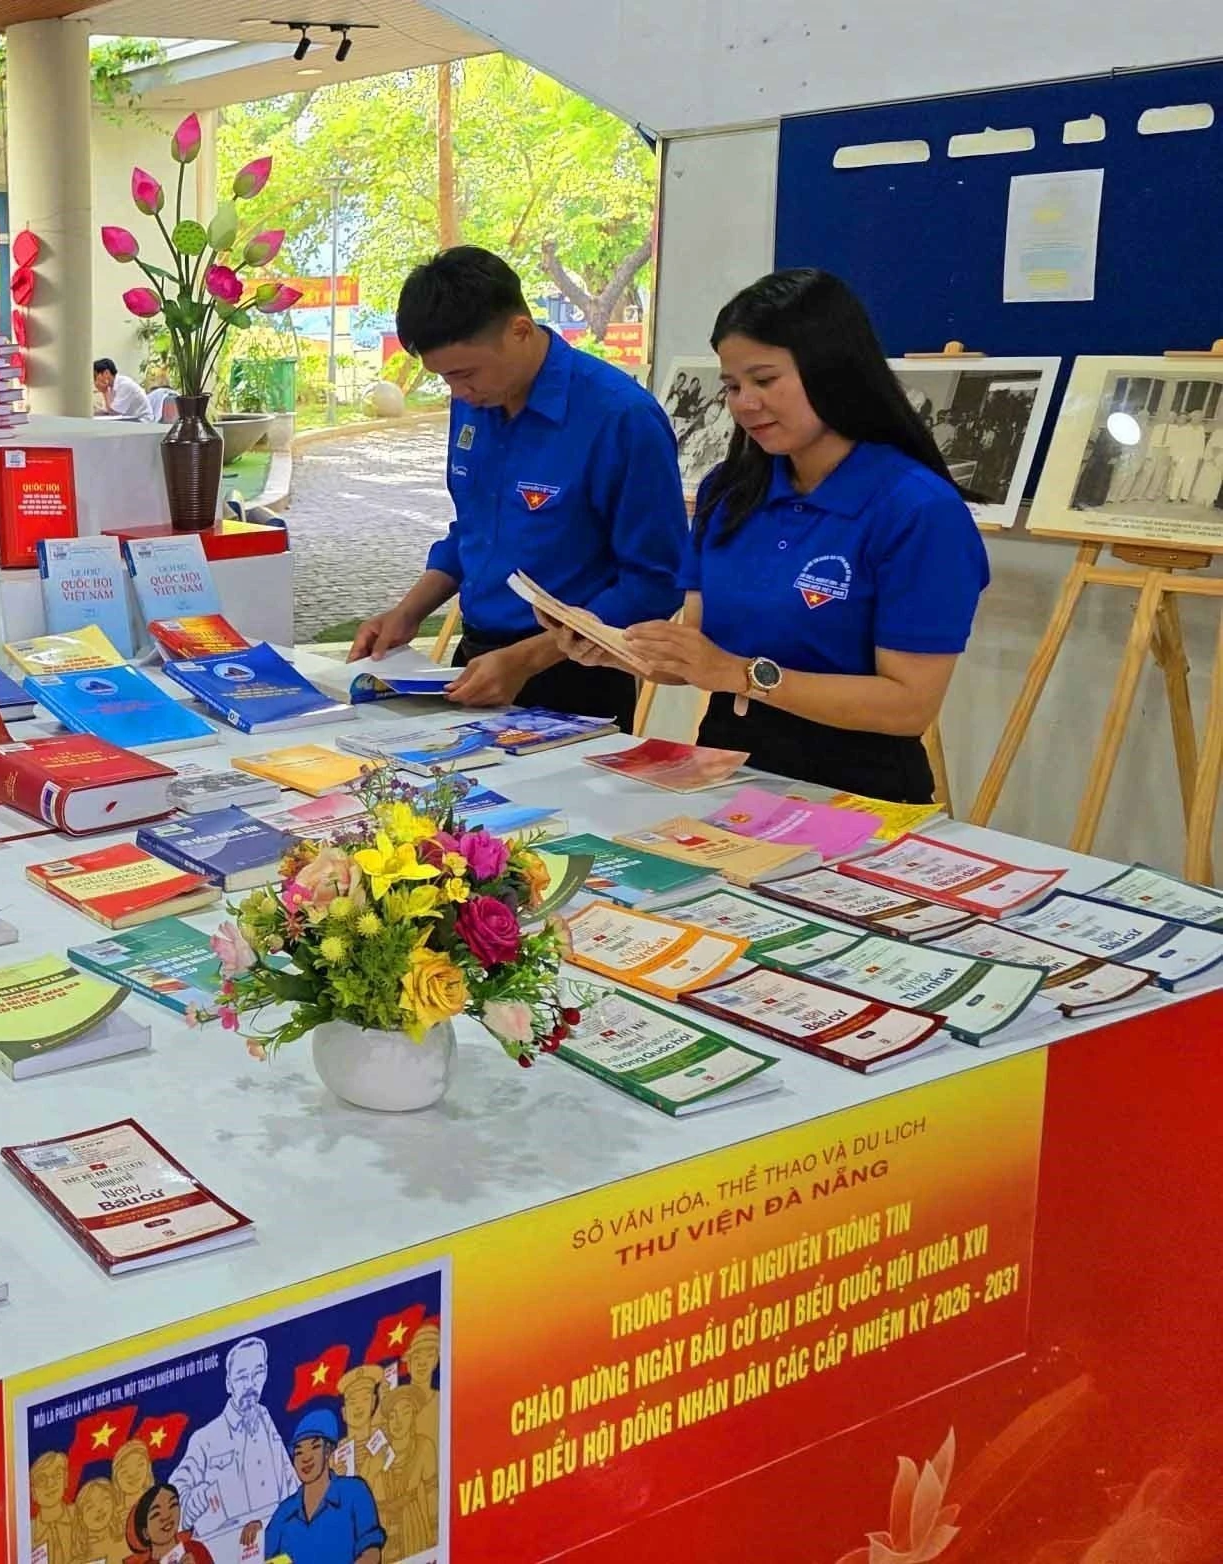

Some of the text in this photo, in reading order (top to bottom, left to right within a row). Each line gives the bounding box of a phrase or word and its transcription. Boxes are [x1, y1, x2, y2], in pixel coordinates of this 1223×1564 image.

[101, 1184, 142, 1199] Ngày
[572, 1117, 926, 1250] SỞ VĂN HÓA, THỂ THAO VÀ DU LỊCH
[614, 1159, 890, 1265] THƯ VIỆN ĐÀ NẴNG
[510, 1224, 988, 1436] CHÀO MỪNG NGÀY BẦU CỬ ĐẠI BIỂU QUỐC HỘI KHÓA XVI
[610, 1202, 912, 1340] TRƯNG BÀY TÀI NGUYÊN THÔNG TIN
[458, 1468, 486, 1517] VÀ
[492, 1459, 526, 1505] ĐẠI
[532, 1429, 577, 1488] BIỂU
[583, 1420, 616, 1468] HỘI
[620, 1400, 672, 1452] ĐỒNG
[678, 1378, 729, 1429] NHÂN
[734, 1362, 770, 1406] DÂN
[775, 1345, 810, 1388] CÁC
[814, 1323, 848, 1374] CẤP
[852, 1308, 904, 1358] NHIỆM
[909, 1293, 930, 1334] KỲ
[933, 1283, 971, 1325] 2026
[984, 1263, 1020, 1304] 2031
